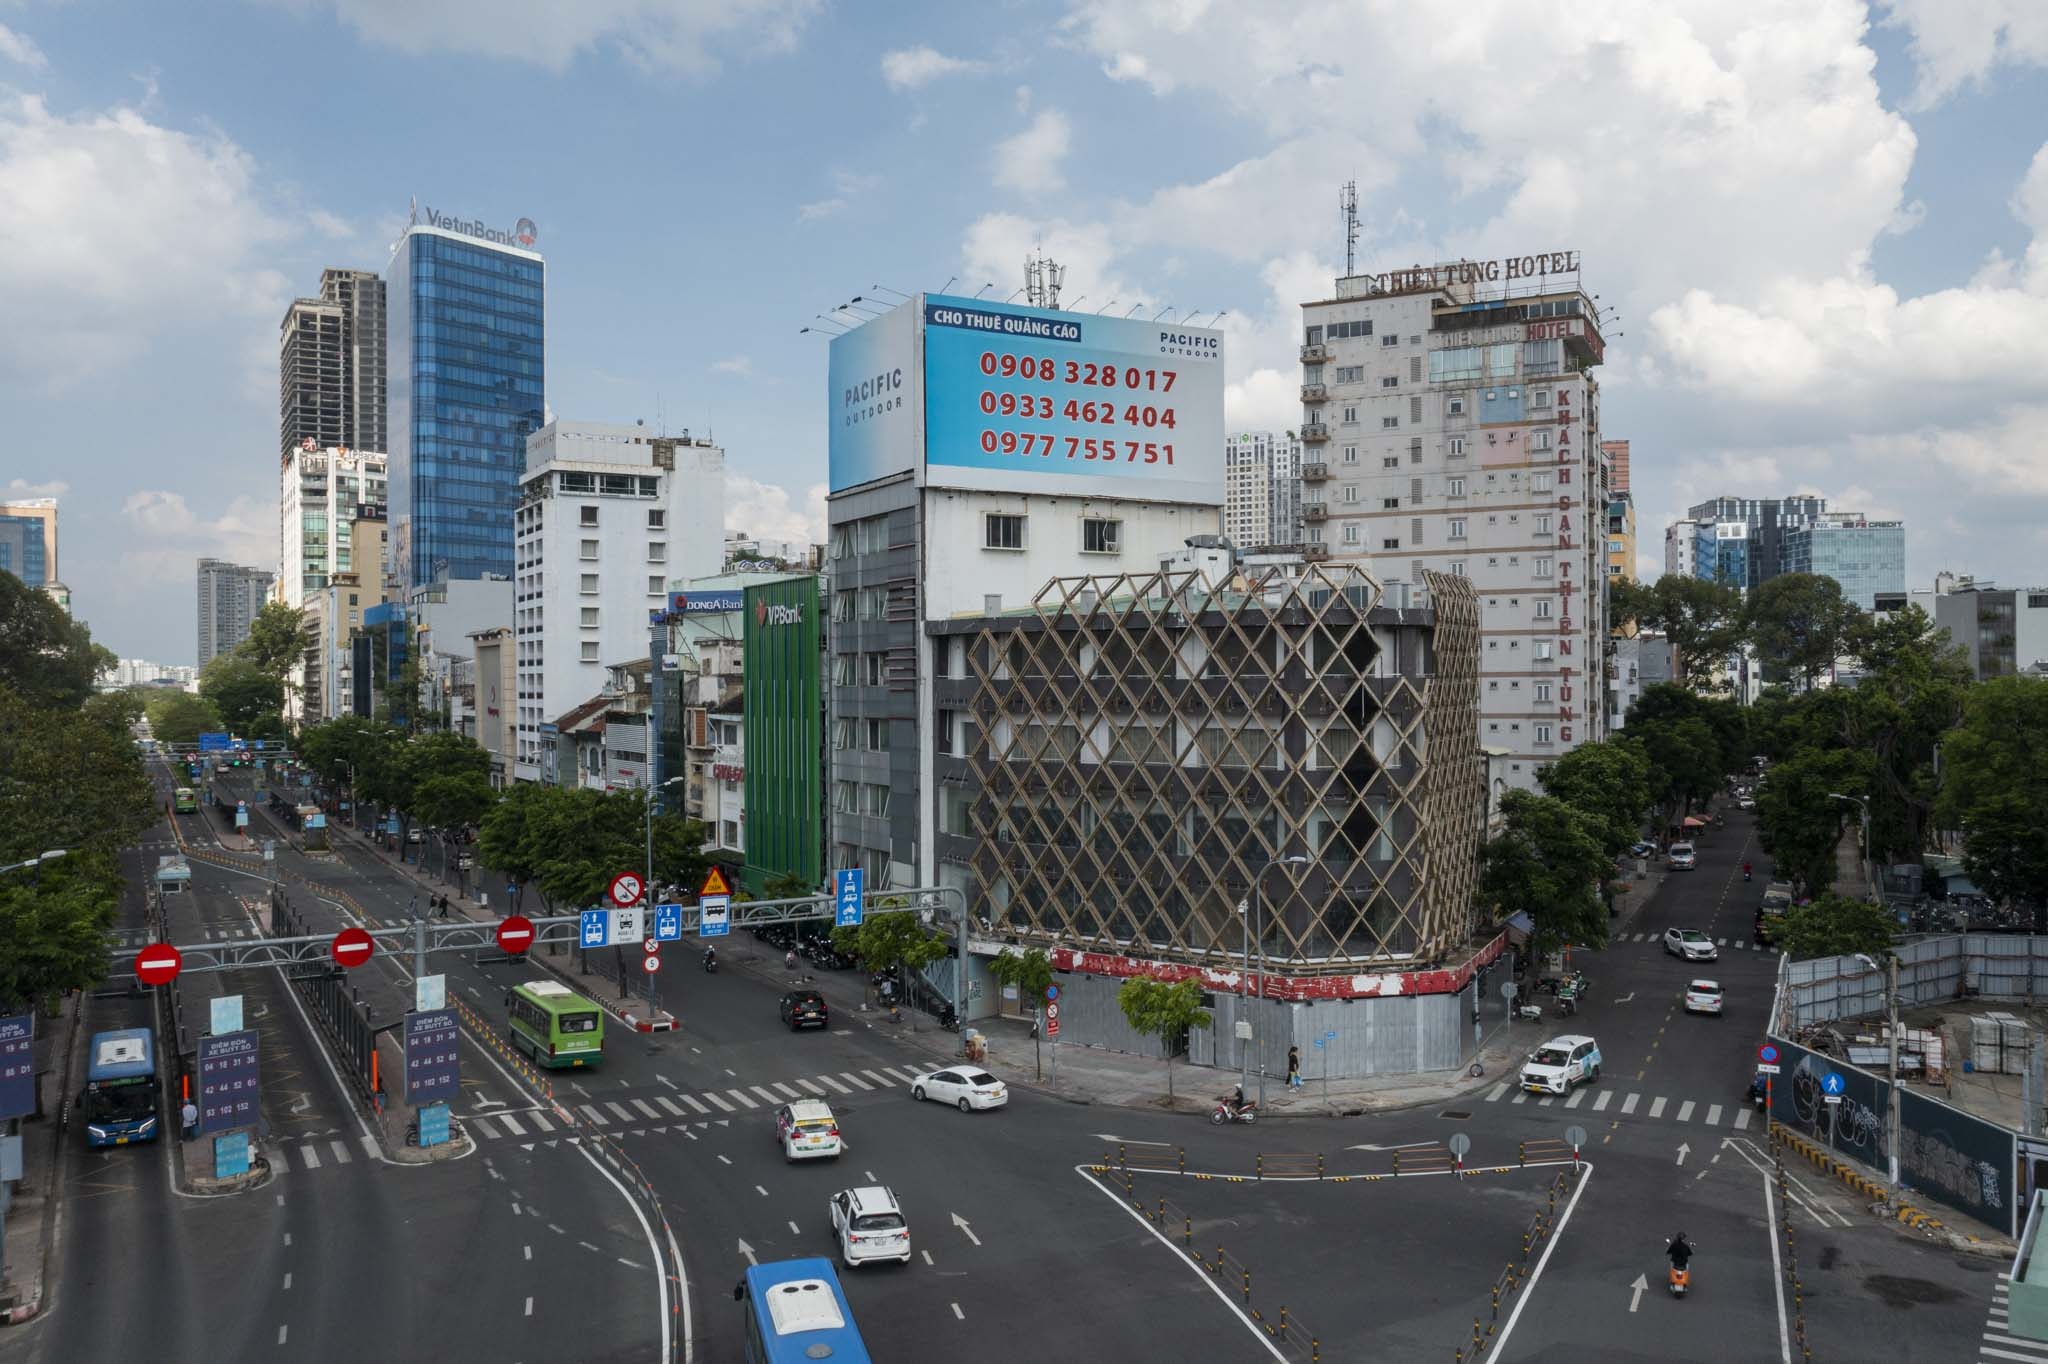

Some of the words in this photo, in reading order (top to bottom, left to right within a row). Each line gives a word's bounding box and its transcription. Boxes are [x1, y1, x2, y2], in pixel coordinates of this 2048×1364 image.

[426, 206, 516, 247] VietinBank
[1505, 250, 1580, 279] HOTEL
[933, 309, 963, 325] CHO
[965, 311, 1001, 331] THUÊ
[1003, 316, 1051, 336] QUẢNG
[1052, 321, 1079, 340] CÁO
[1160, 331, 1218, 349] PACIFIC
[1527, 320, 1576, 341] HOTEL
[1159, 346, 1219, 359] OUTDOOR
[980, 351, 1056, 382] 0908
[1063, 361, 1117, 388] 328
[1124, 366, 1178, 393] 017
[845, 368, 903, 408] PACIFIC
[846, 397, 902, 427] OUTDOOR
[979, 391, 1055, 420] 0933
[1063, 399, 1116, 426] 462
[1123, 405, 1177, 430] 404
[980, 430, 1055, 457] 0977
[1063, 436, 1117, 462] 755
[1123, 441, 1175, 466] 751
[1557, 390, 1572, 485] KHÁCH
[1558, 495, 1573, 551] SẠN
[1868, 521, 1904, 529] CREDIT
[767, 603, 803, 626] VPBank
[1558, 561, 1573, 656] THIÊN
[1559, 666, 1573, 742] TÙNG
[436, 1033, 444, 1042] 31
[233, 1058, 241, 1067] 31
